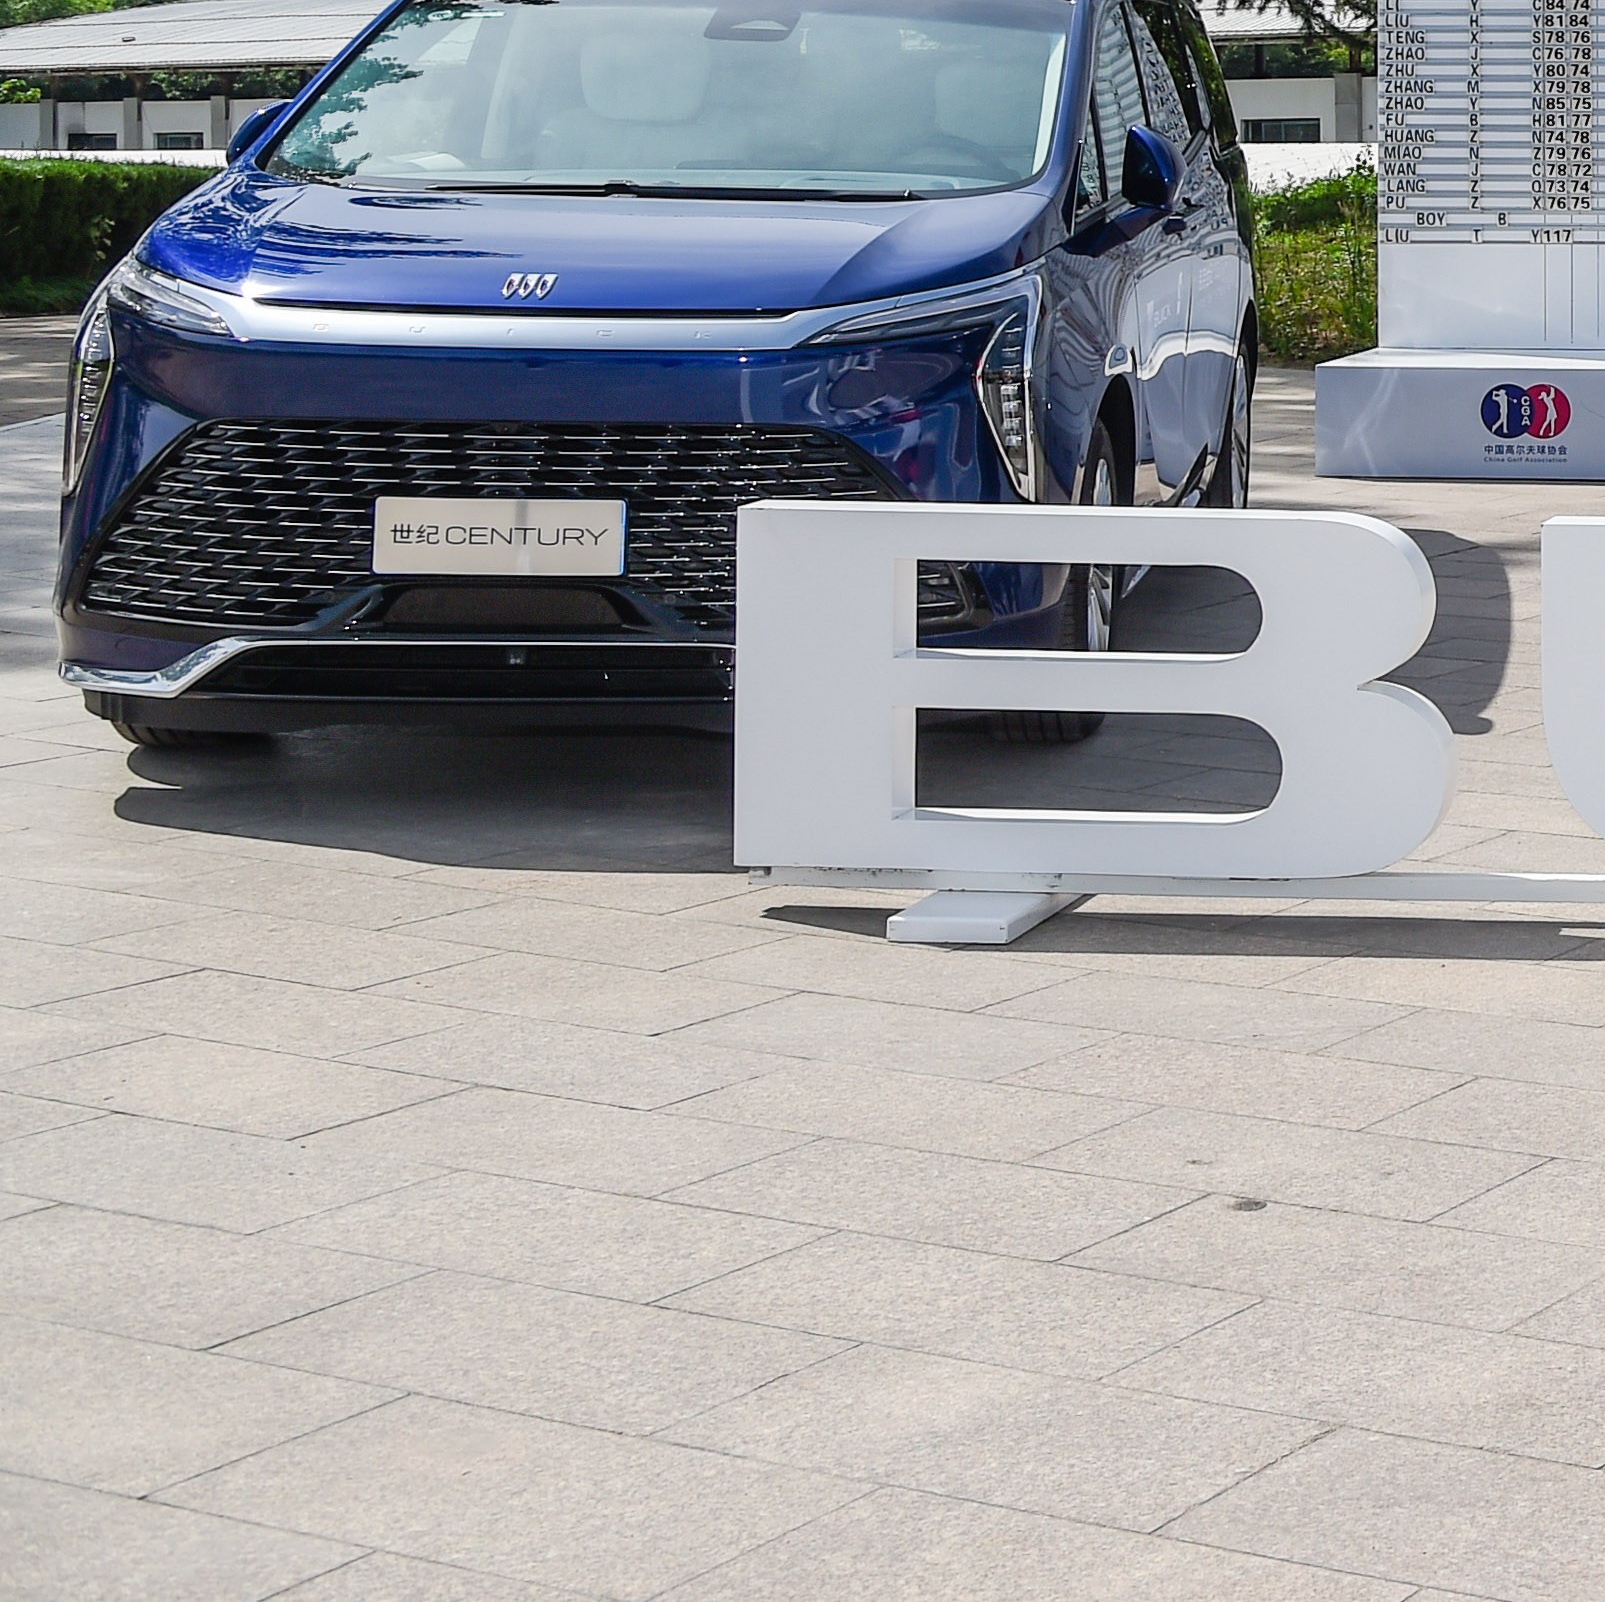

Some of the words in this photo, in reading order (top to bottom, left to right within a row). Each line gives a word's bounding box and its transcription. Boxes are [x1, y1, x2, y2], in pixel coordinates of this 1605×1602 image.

[1387, 180, 1426, 193] LANG
[1470, 180, 1479, 193] Z
[1531, 180, 1542, 193] Q
[1547, 180, 1566, 193] 73
[1571, 180, 1590, 193] 74
[1521, 396, 1531, 426] CGA
[1484, 445, 1567, 455] 中国高尔夫球协会
